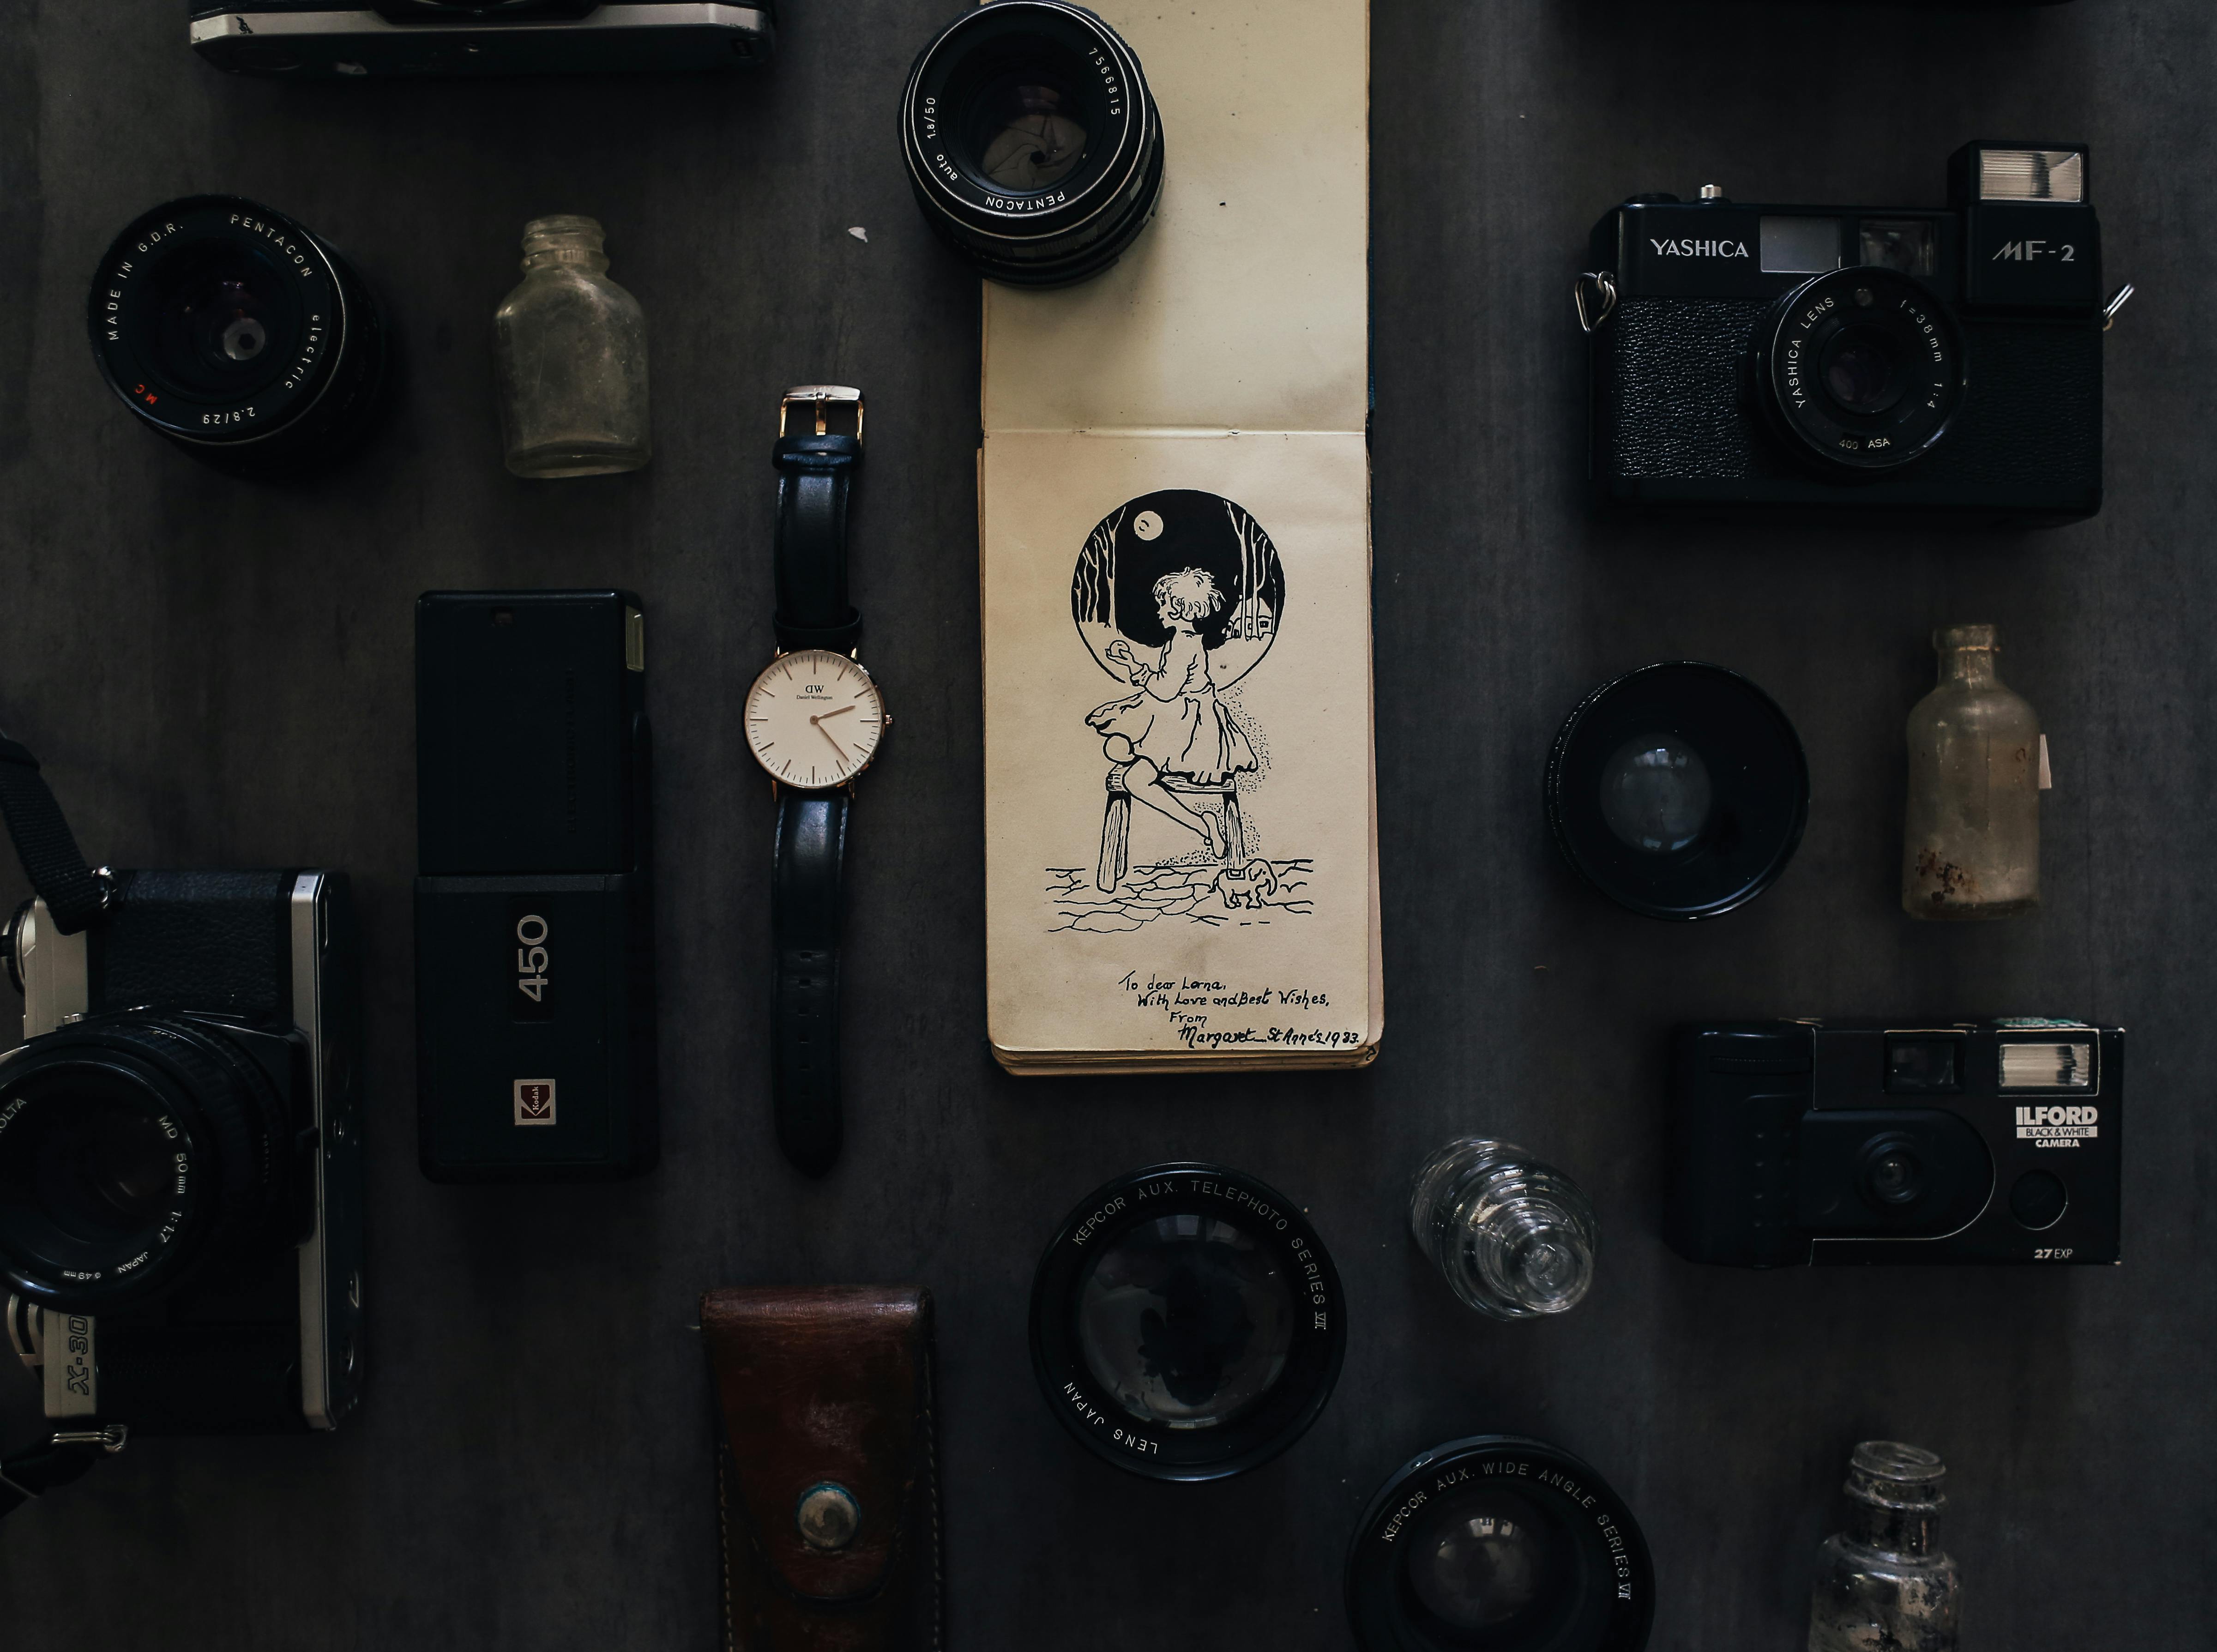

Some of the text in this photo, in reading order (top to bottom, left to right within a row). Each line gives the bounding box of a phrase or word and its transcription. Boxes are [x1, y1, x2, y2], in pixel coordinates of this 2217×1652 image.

[1088, 48, 1121, 115] 7566815
[923, 97, 1066, 211] PENTACON auto 1.8/50
[230, 214, 313, 277] PENTACON
[1650, 239, 1749, 258] YASHICA
[1992, 240, 2075, 262] MF-2
[107, 223, 184, 341] MADE IN G.D.R.
[285, 314, 322, 389] electric
[1787, 297, 1835, 408] YASHICA LENS
[1927, 382, 1943, 409] 1:4
[203, 407, 256, 424] 2.8/29
[1839, 437, 1892, 450] 400 ASA
[517, 914, 548, 1002] 450
[1118, 970, 1139, 991] To
[1147, 973, 1176, 990] dear
[1137, 987, 1330, 1011] With Love and Best Wishes,
[1169, 1010, 1207, 1028] From
[1267, 1027, 1283, 1043] St
[158, 1114, 178, 1139] MD
[2016, 1105, 2098, 1126] ILFORD
[2026, 1127, 2090, 1137] BLACK & WHITE
[2035, 1139, 2080, 1148] CAMERA
[176, 1152, 189, 1194] 50mm
[1072, 1196, 1127, 1246] KEPCOR
[1138, 1181, 1178, 1200] AUX.
[1191, 1180, 1288, 1230] TELEPHOTO
[1291, 1237, 1325, 1305] SERIES
[2034, 1248, 2073, 1259] 27 EXP
[117, 1251, 148, 1274] JAPAN
[1064, 1382, 1158, 1454] LENS JAPAN
[1382, 1490, 1427, 1542] KEPCOR
[1436, 1467, 1475, 1492] AUX.
[1482, 1462, 1530, 1476] WIDE
[1538, 1469, 1596, 1508] ANGLE
[1597, 1514, 1630, 1578] SERIES
